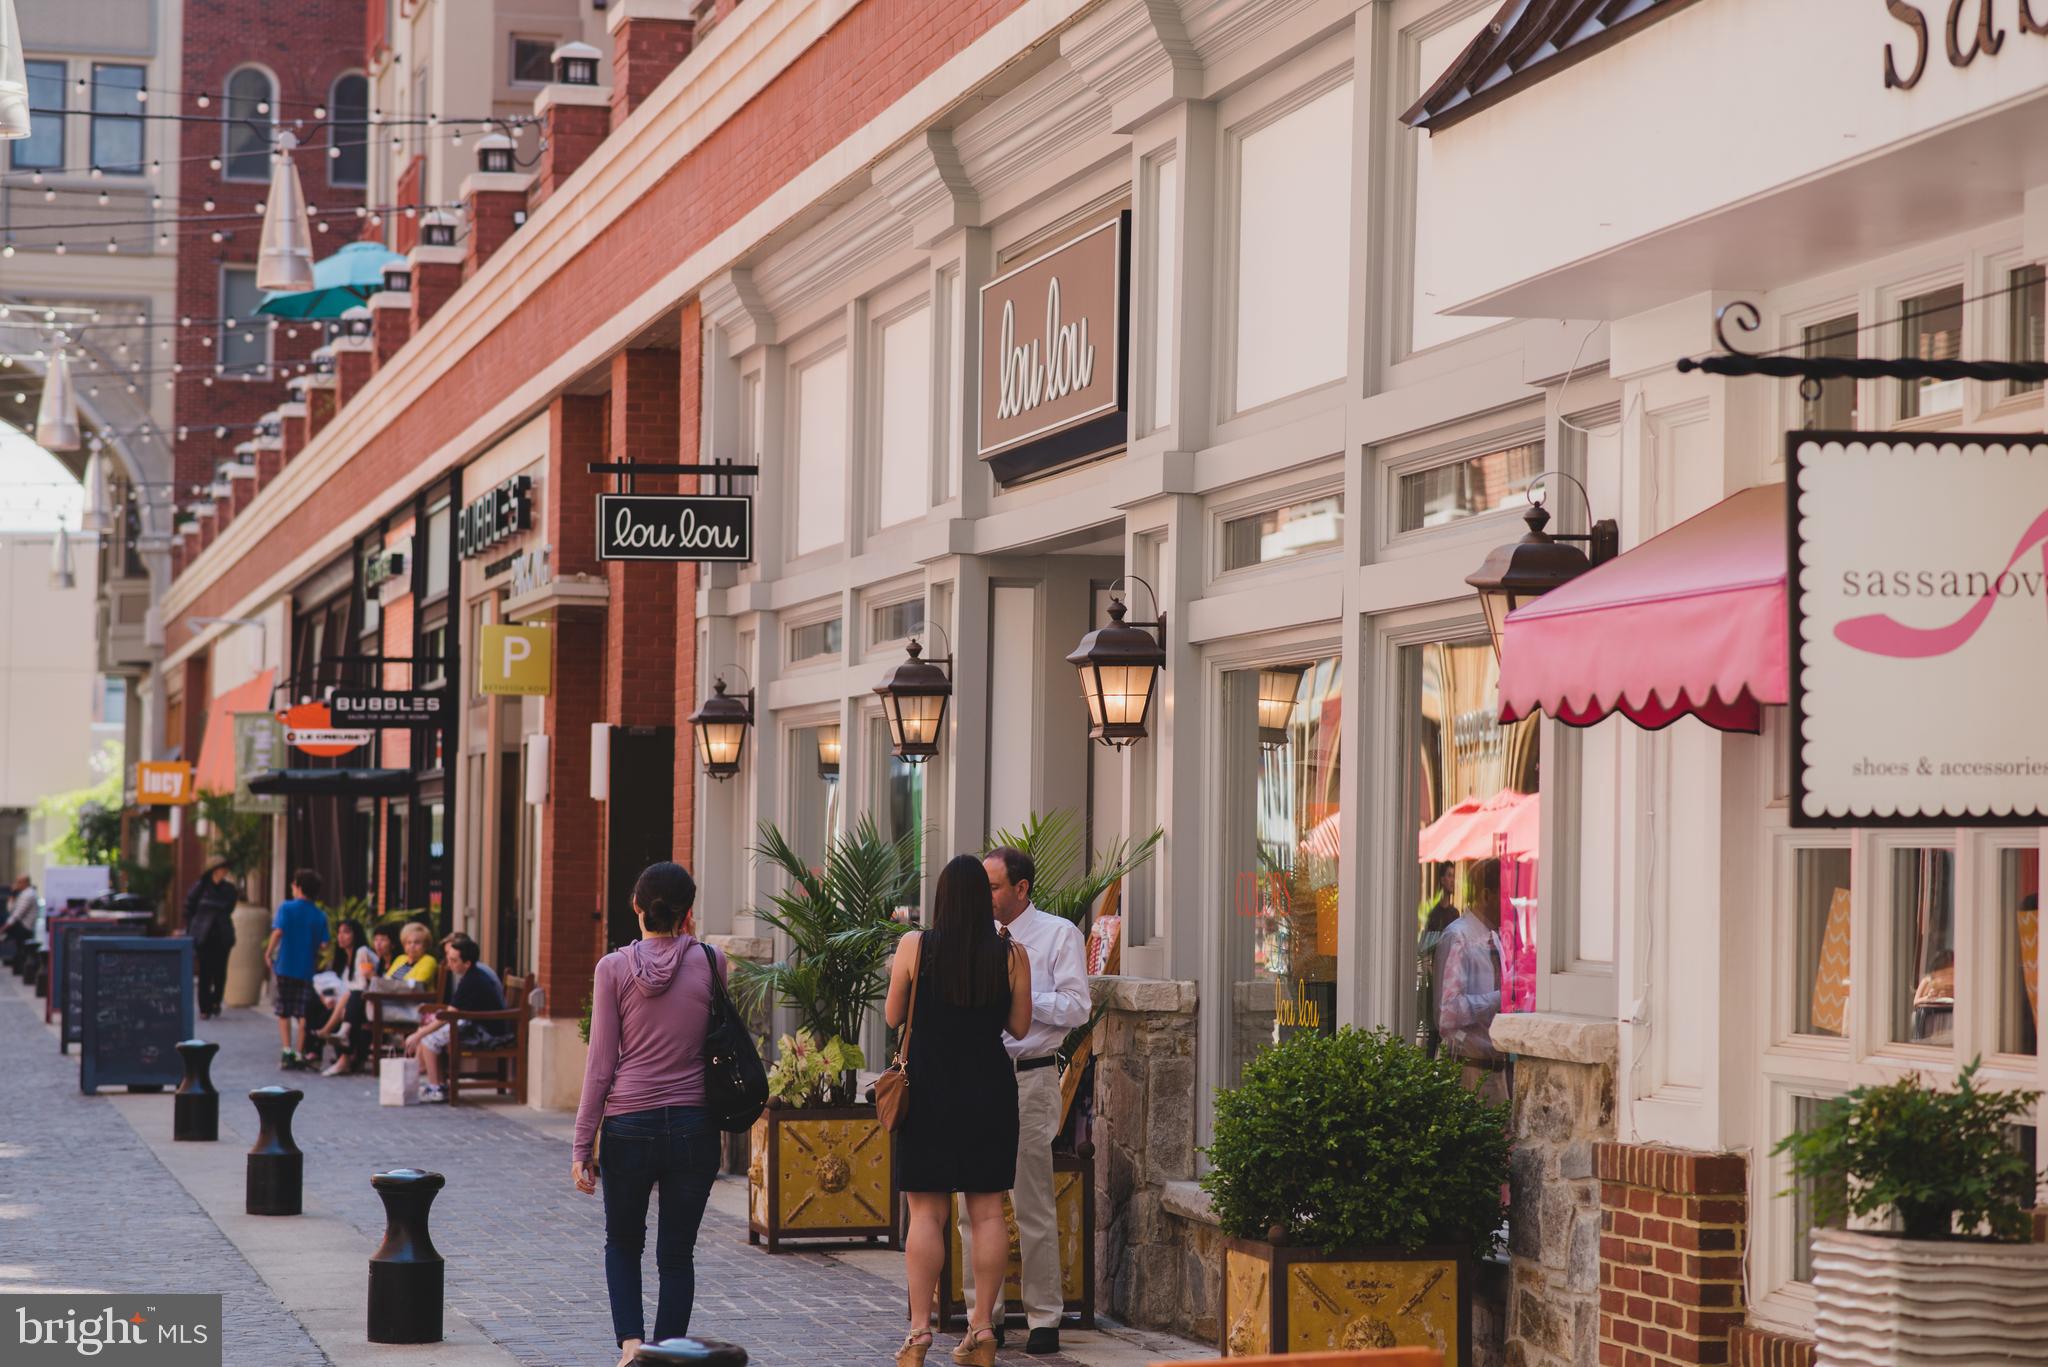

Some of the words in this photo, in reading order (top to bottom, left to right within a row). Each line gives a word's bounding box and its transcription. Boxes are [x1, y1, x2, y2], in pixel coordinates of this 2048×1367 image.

[998, 299, 1045, 420] lou
[1046, 276, 1095, 402] lou
[612, 507, 676, 548] lou
[680, 508, 740, 548] lou
[1842, 568, 2048, 598] sassanov
[503, 636, 532, 679] P
[336, 697, 440, 711] BUBBLES
[143, 767, 183, 798] lucy
[1851, 756, 1909, 776] shoes
[1915, 756, 1933, 776] &
[1275, 977, 1296, 1026] lou
[1297, 976, 1320, 1028] lou
